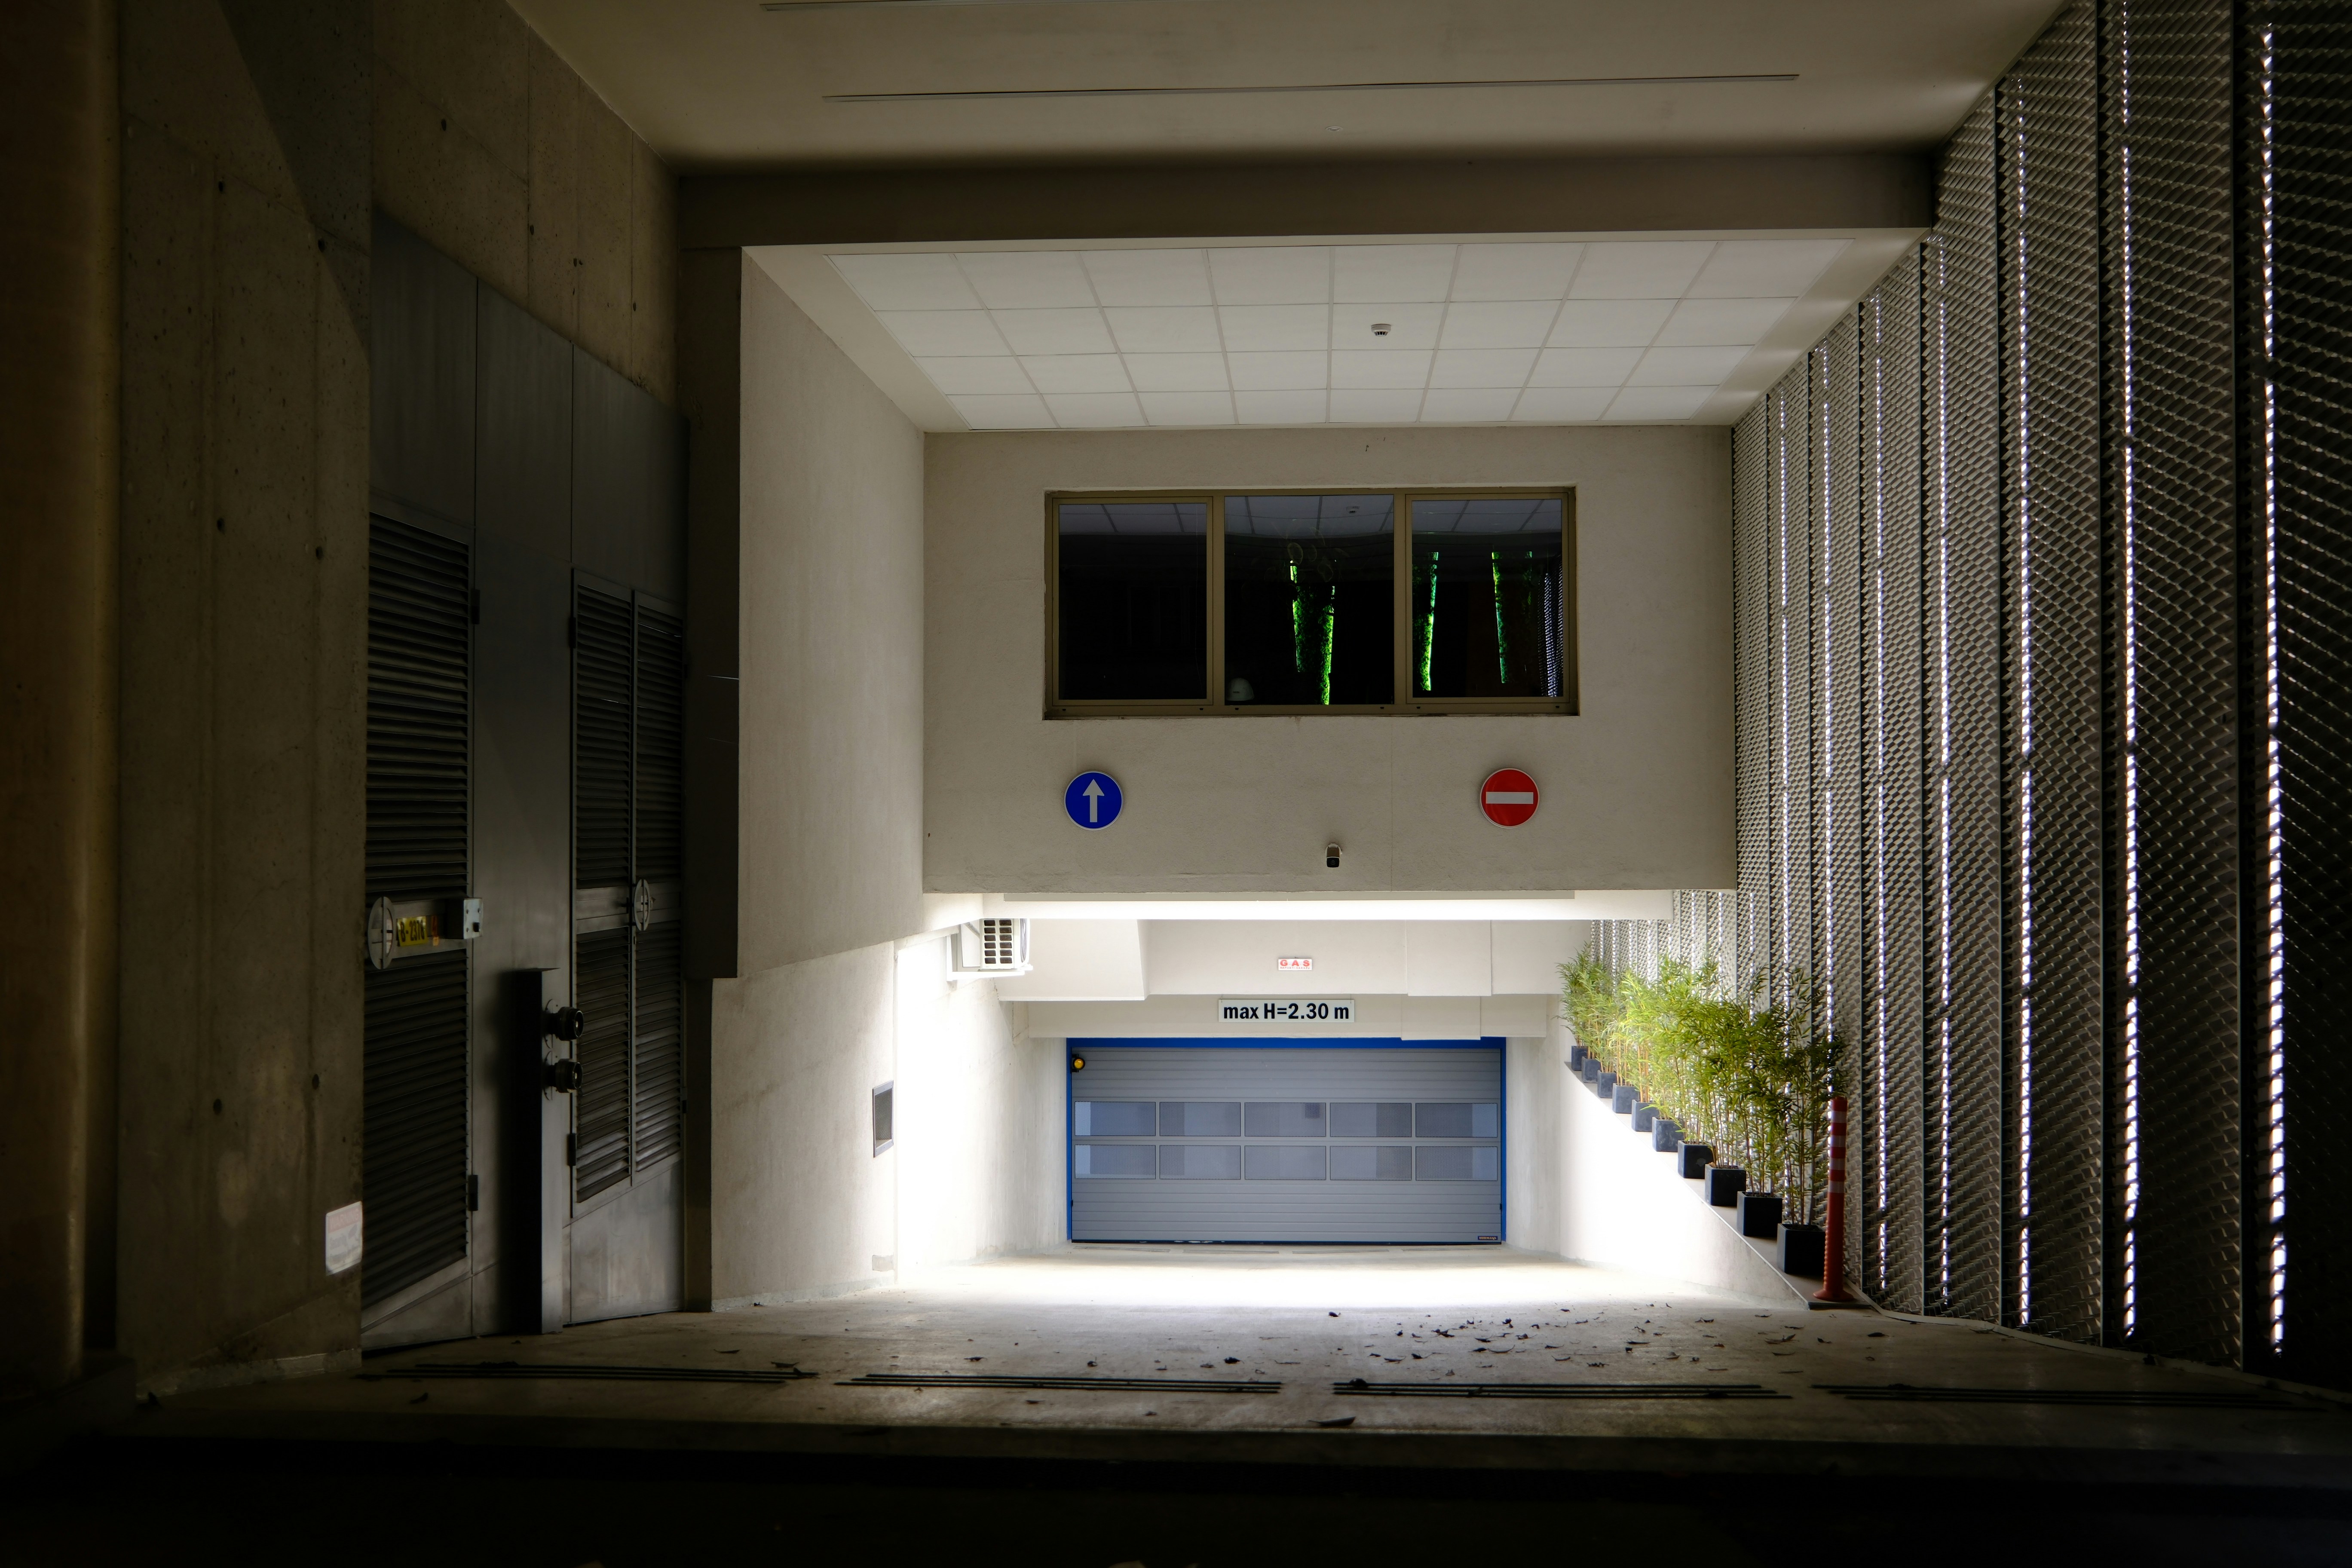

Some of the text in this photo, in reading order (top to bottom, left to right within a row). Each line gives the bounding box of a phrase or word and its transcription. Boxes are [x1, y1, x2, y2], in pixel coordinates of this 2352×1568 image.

[1224, 1003, 1349, 1019] max H=2.30 m
